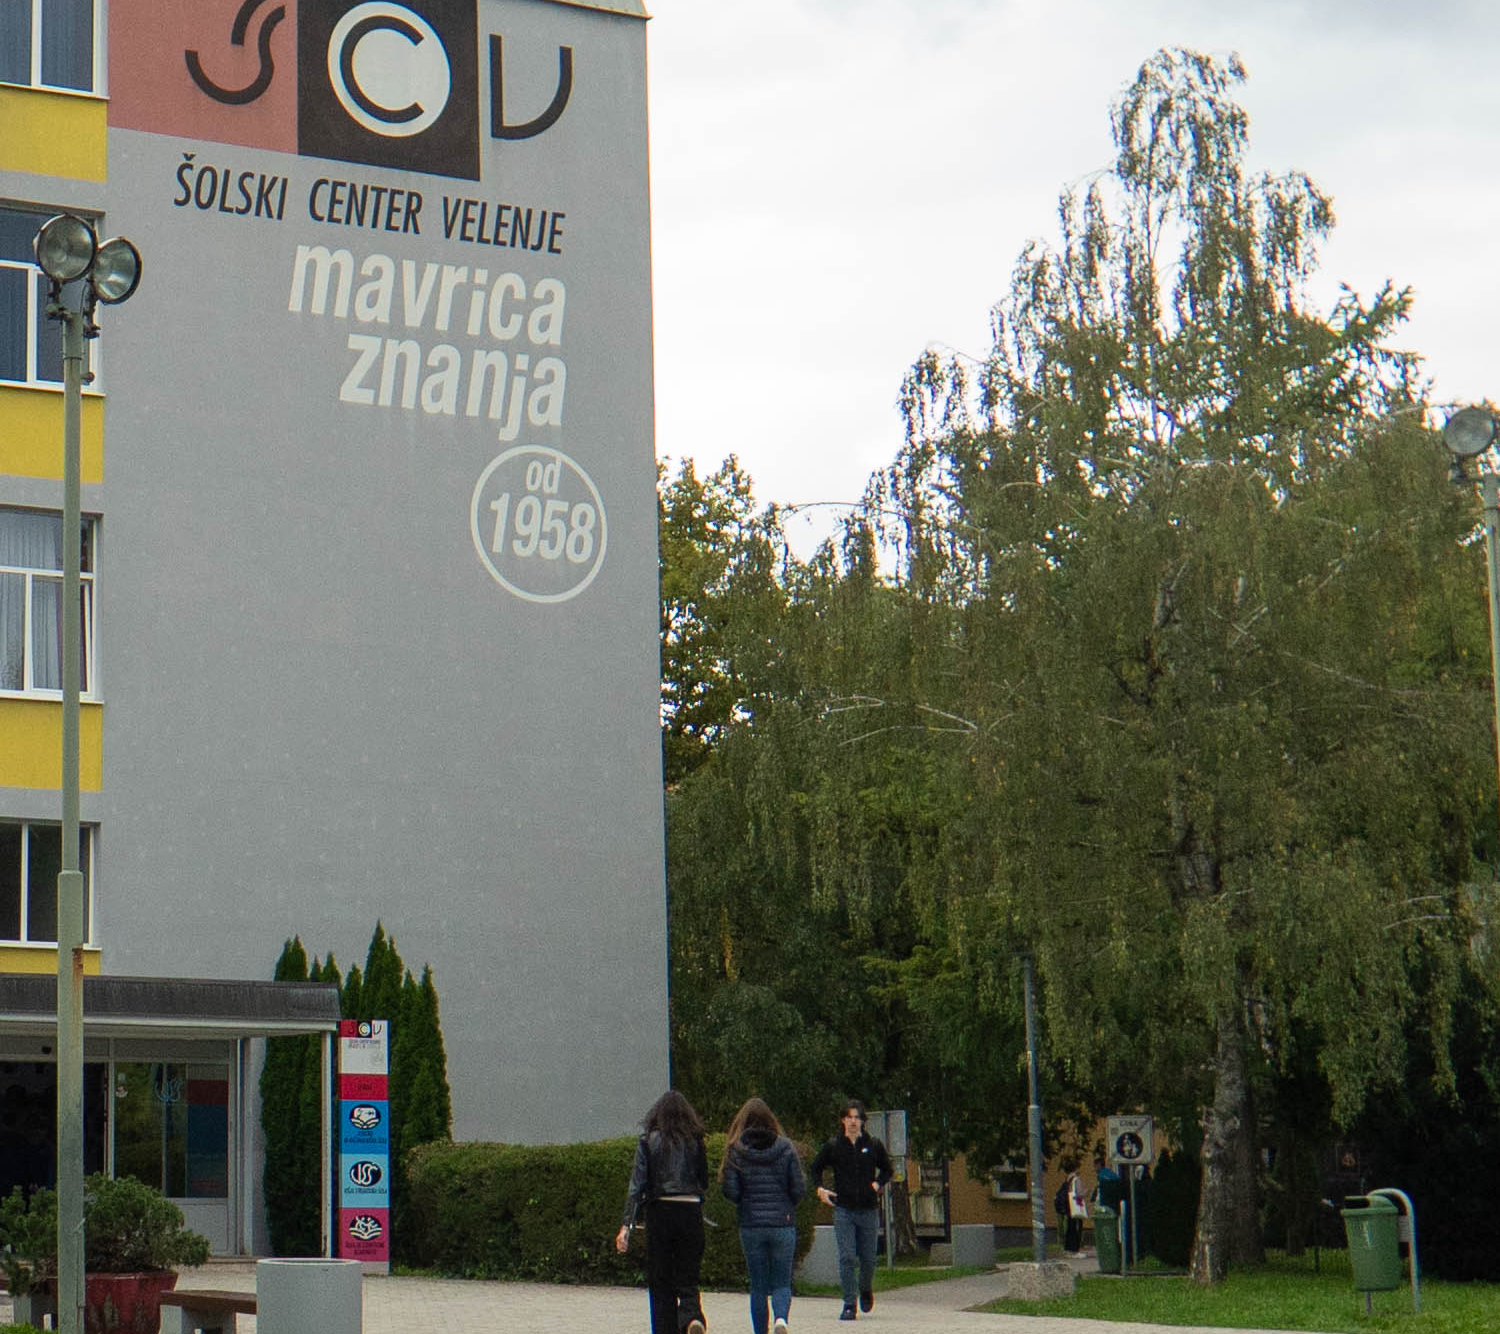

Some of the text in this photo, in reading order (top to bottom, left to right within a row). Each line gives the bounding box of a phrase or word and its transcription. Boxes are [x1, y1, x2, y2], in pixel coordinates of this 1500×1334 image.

[173, 153, 567, 255] ŠOLSKI CENTER VELENJE
[288, 244, 567, 346] mavrica
[339, 333, 568, 442] znanja
[525, 455, 563, 495] od
[490, 492, 596, 564] 1958
